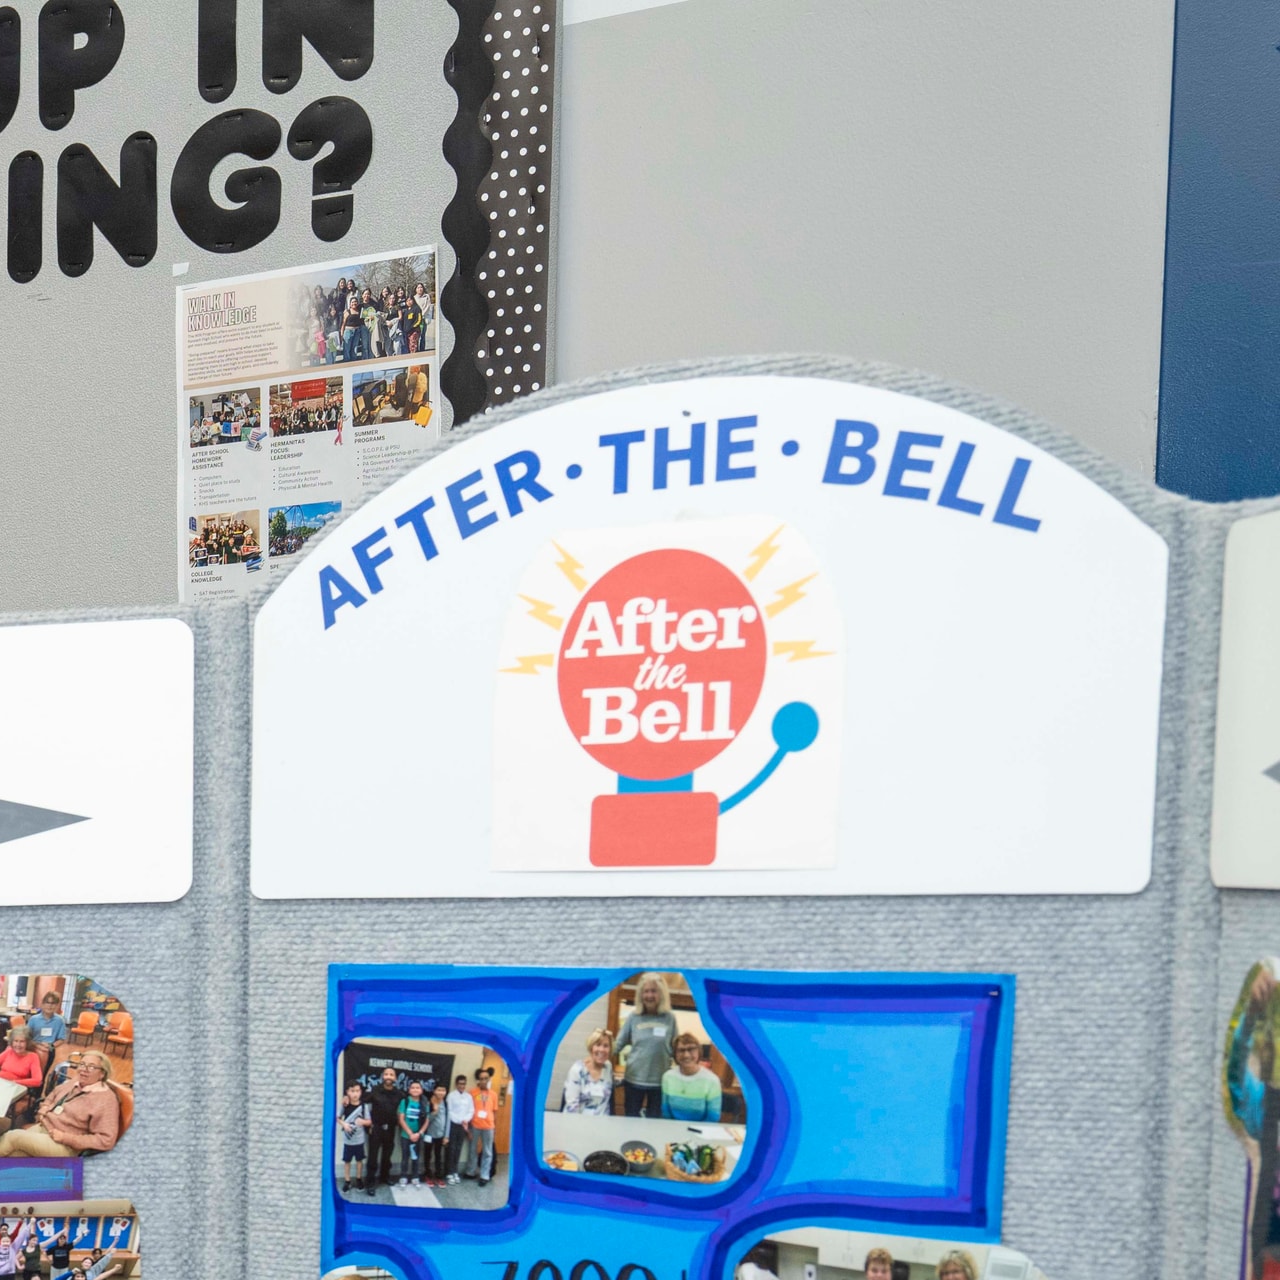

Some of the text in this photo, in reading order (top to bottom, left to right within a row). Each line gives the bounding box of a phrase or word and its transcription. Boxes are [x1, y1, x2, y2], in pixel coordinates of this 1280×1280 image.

[188, 291, 235, 314] WALK IN
[188, 306, 256, 332] KNOWLEDGE
[354, 430, 378, 438] SUMMER
[270, 438, 305, 447] HERMANITAS
[354, 436, 385, 444] PROGRAMS
[208, 448, 229, 456] SCHOOL
[270, 452, 303, 460] LEADERSHIP
[192, 456, 222, 464] HOMEWORK
[192, 462, 224, 470] ASSISTANCE
[318, 414, 1043, 632] AFTER THE BELL
[190, 570, 214, 578] COLLEGE
[190, 576, 222, 584] KNOWLEDGE
[564, 596, 758, 659] After
[634, 655, 688, 692] the
[581, 682, 735, 746] Bell
[413, 1062, 433, 1073] SCHOOL
